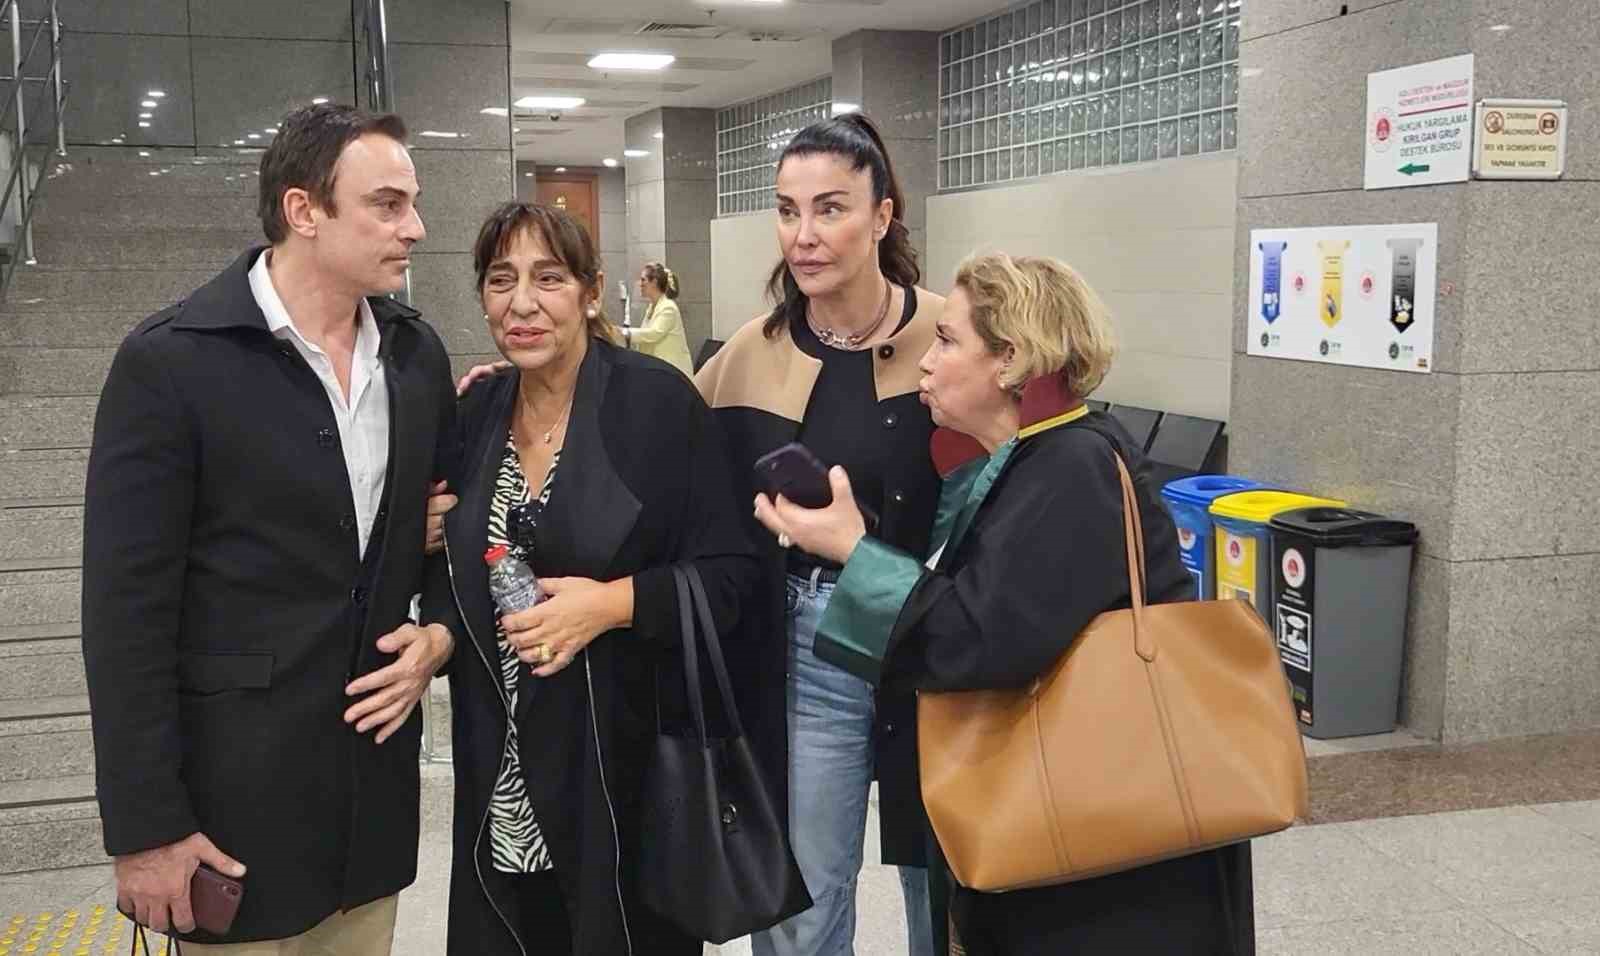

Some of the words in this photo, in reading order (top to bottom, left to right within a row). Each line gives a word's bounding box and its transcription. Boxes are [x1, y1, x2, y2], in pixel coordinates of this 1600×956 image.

[1424, 113, 1467, 128] YARGILAMA
[1403, 132, 1436, 143] KIRILGAN
[1439, 128, 1461, 139] GRUP
[1399, 145, 1428, 157] DESTEK
